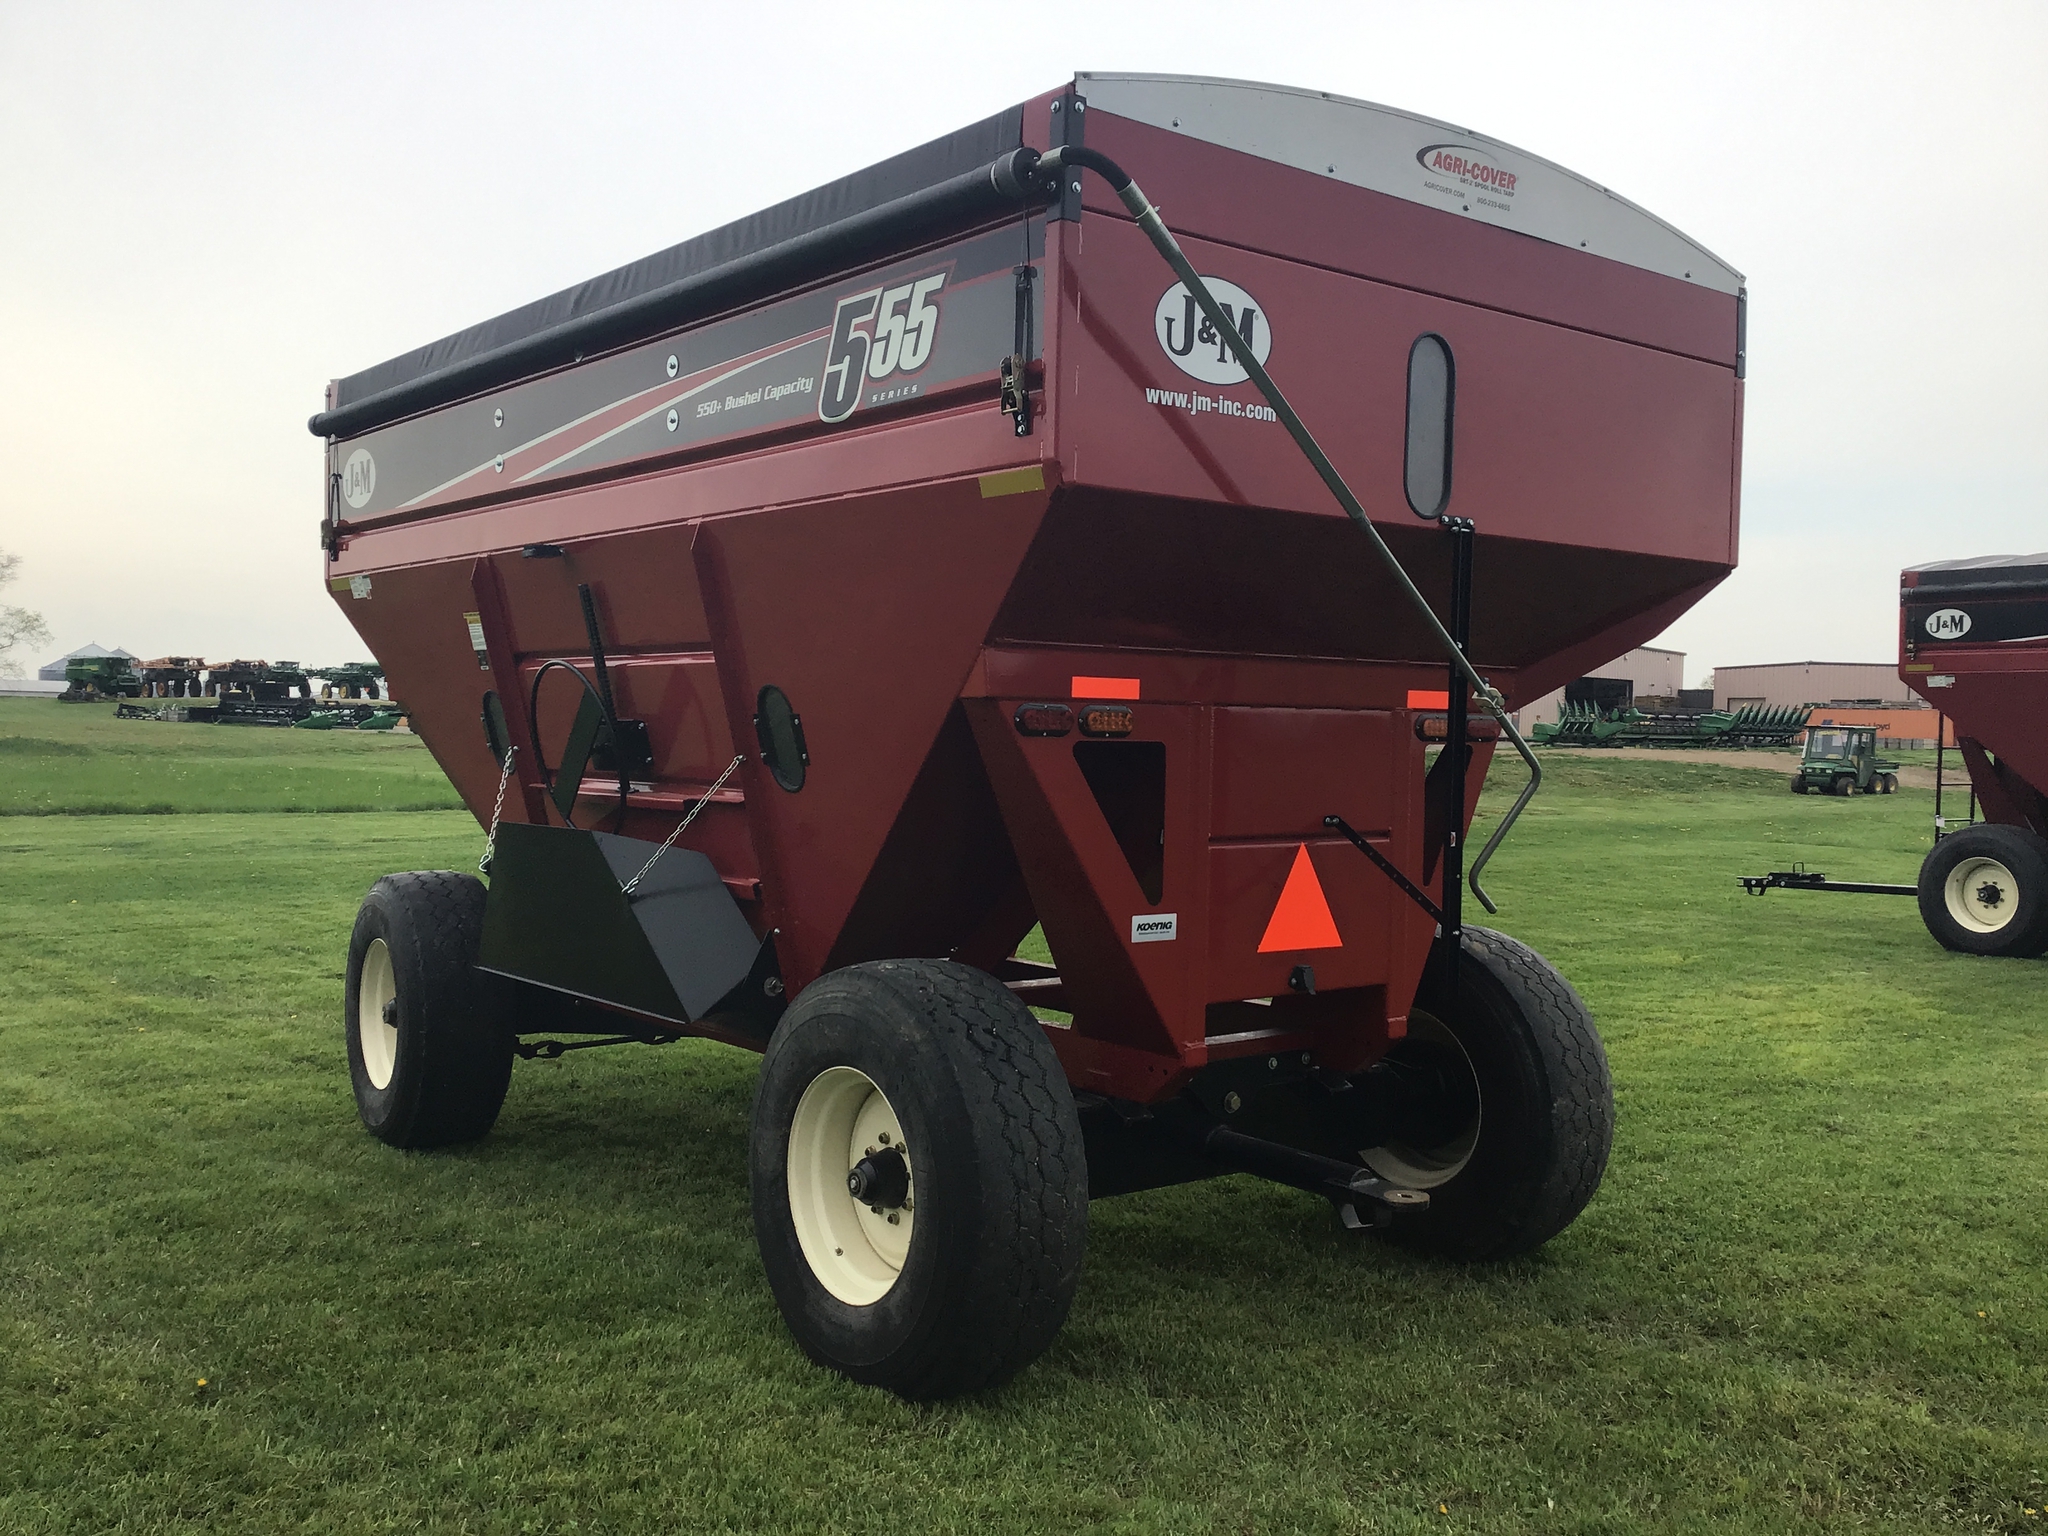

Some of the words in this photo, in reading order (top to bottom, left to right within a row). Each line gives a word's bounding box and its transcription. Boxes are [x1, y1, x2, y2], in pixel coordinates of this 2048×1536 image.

[1423, 180, 1466, 199] AGRICOVER.COM
[1433, 151, 1518, 190] AGRI-COVER
[818, 272, 946, 424] 555
[1164, 294, 1256, 367] J&M
[696, 402, 722, 418] 550+
[725, 387, 762, 411] Bushel
[764, 377, 814, 401] Capacity
[871, 384, 918, 403] SERIES
[1145, 387, 1277, 422] www.jm-inc.com
[345, 458, 371, 498] J&M
[1929, 615, 1965, 634] J&M
